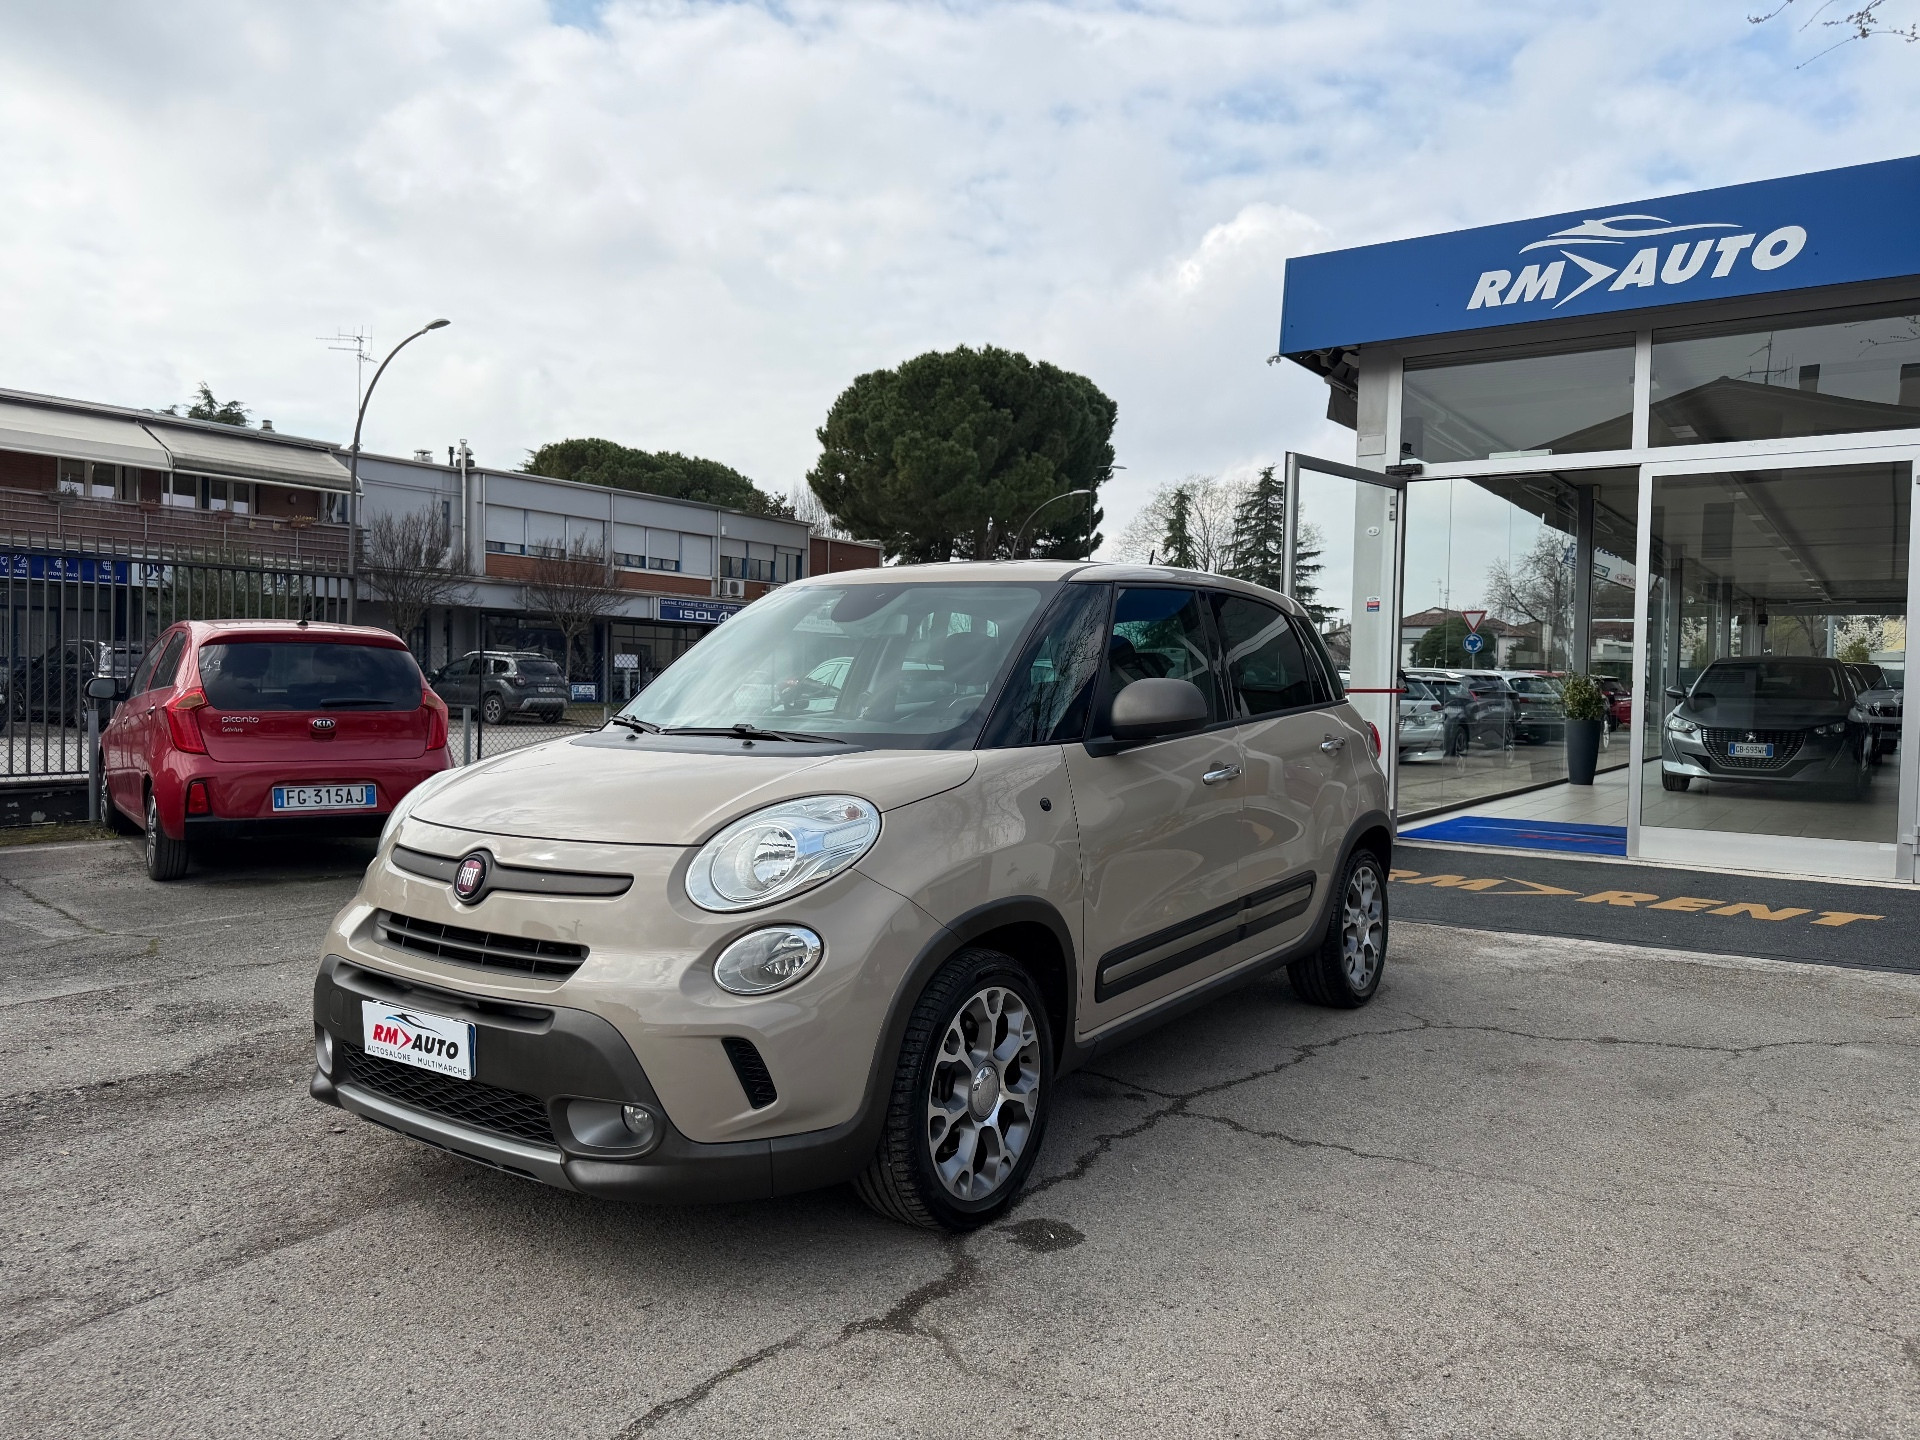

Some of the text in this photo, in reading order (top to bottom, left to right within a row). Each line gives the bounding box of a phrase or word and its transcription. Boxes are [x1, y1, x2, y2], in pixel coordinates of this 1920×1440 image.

[1466, 225, 1807, 310] RM AUTO
[680, 609, 733, 623] ISOLA
[221, 715, 259, 725] picanto
[458, 867, 478, 887] FIAT
[1576, 890, 1886, 927] RENT
[372, 1024, 459, 1060] RM AUTO
[367, 1045, 467, 1077] AUTOSALONE MULTIMARCHE
